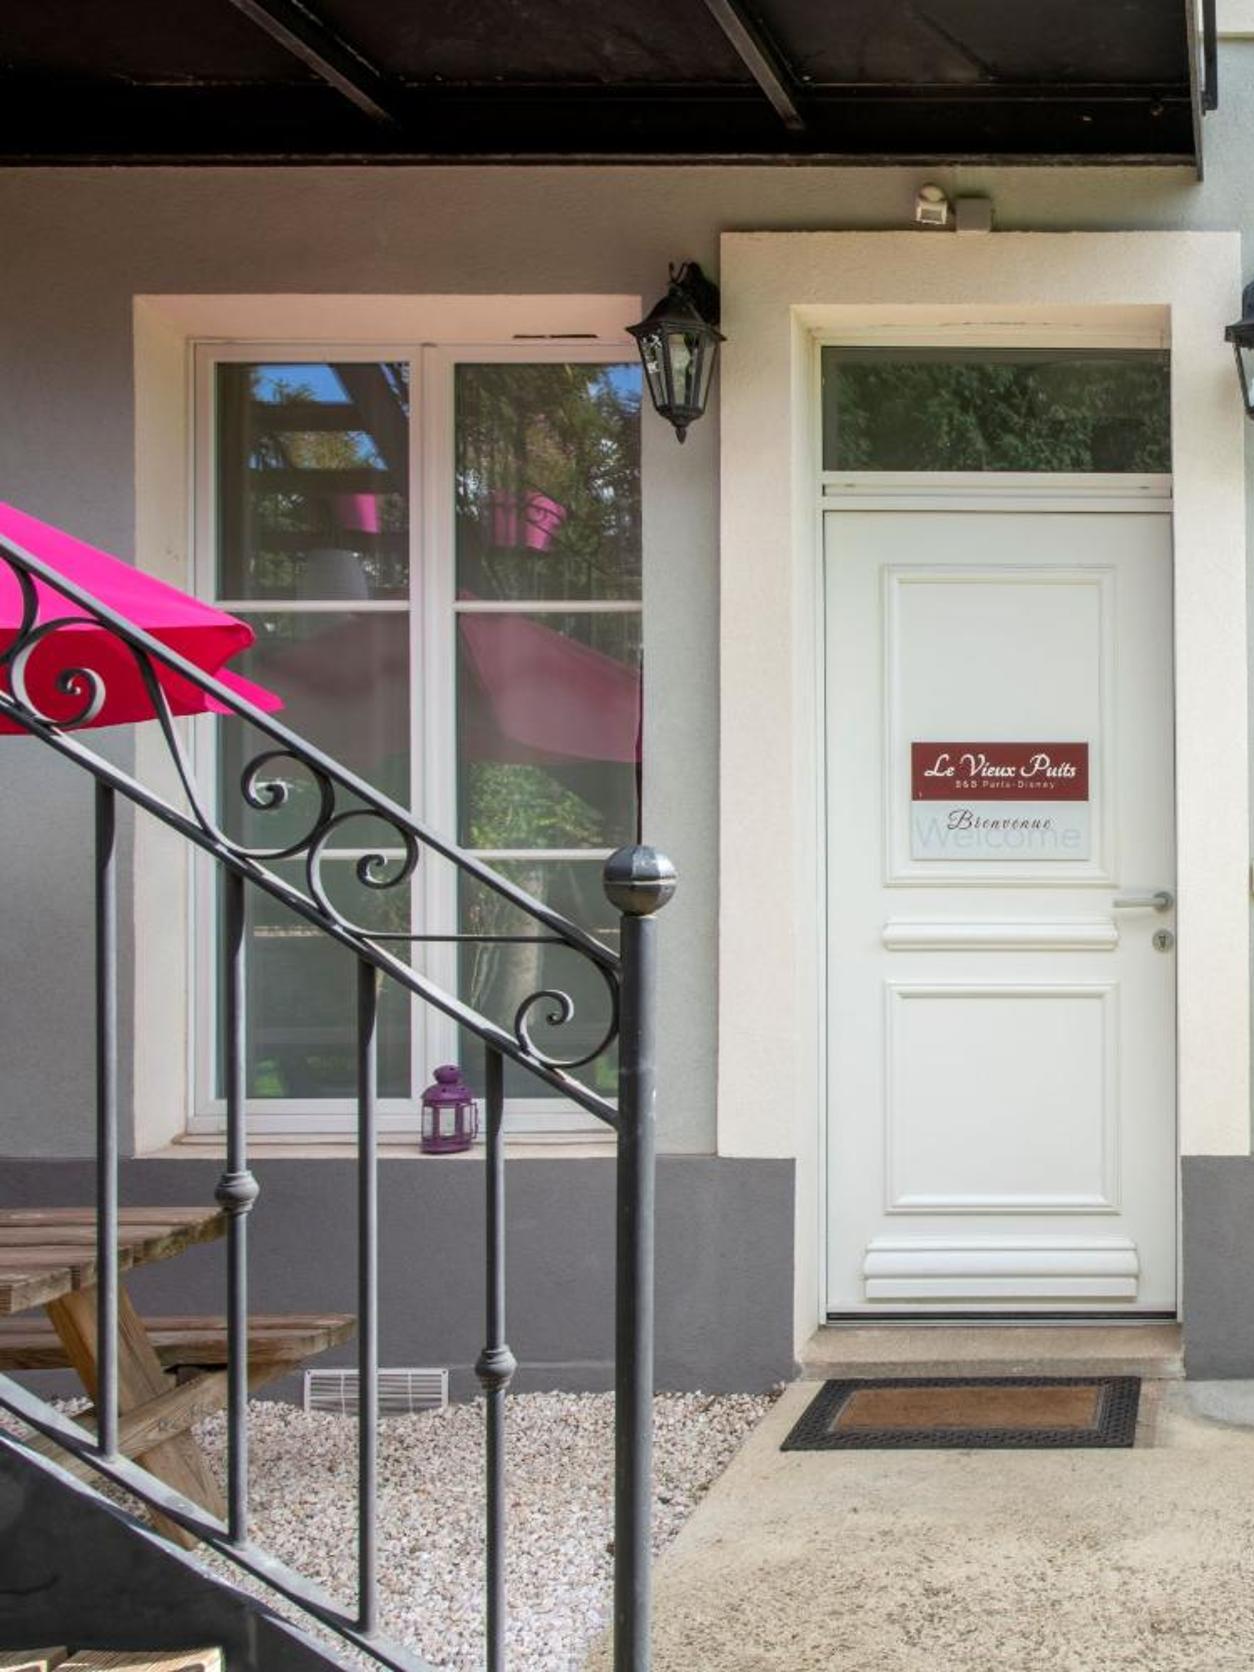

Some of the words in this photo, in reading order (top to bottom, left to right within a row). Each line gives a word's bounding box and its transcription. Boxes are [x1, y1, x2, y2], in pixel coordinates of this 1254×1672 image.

[924, 753, 955, 777] Le
[959, 753, 1017, 777] Vieux
[1020, 753, 1077, 778] Puits
[955, 780, 978, 789] B&B
[947, 808, 1054, 830] Bienvenue
[915, 815, 1082, 849] Welcome
